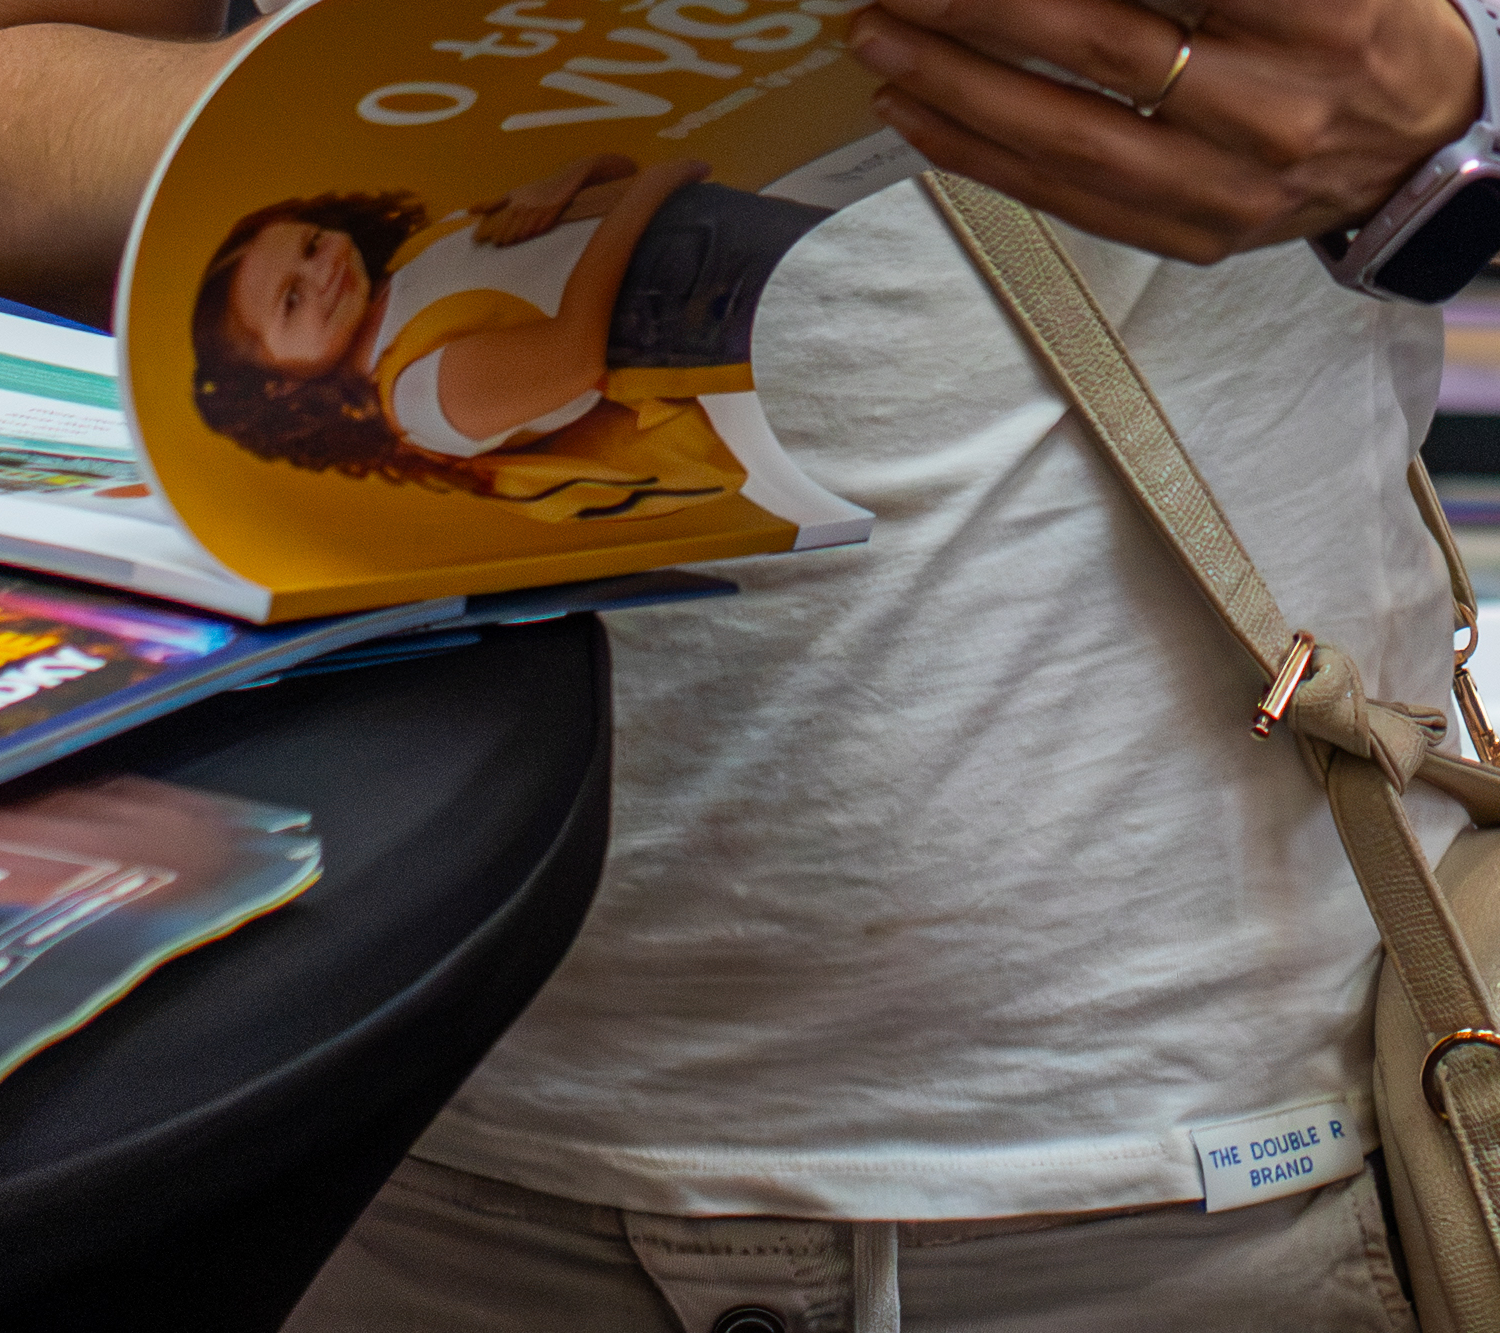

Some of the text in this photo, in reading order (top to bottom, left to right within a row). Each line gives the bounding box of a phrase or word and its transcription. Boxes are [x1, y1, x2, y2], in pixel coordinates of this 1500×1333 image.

[356, 80, 479, 128] O
[1209, 1119, 1346, 1169] THE DOUBLE R
[1249, 1155, 1314, 1188] BRAND
